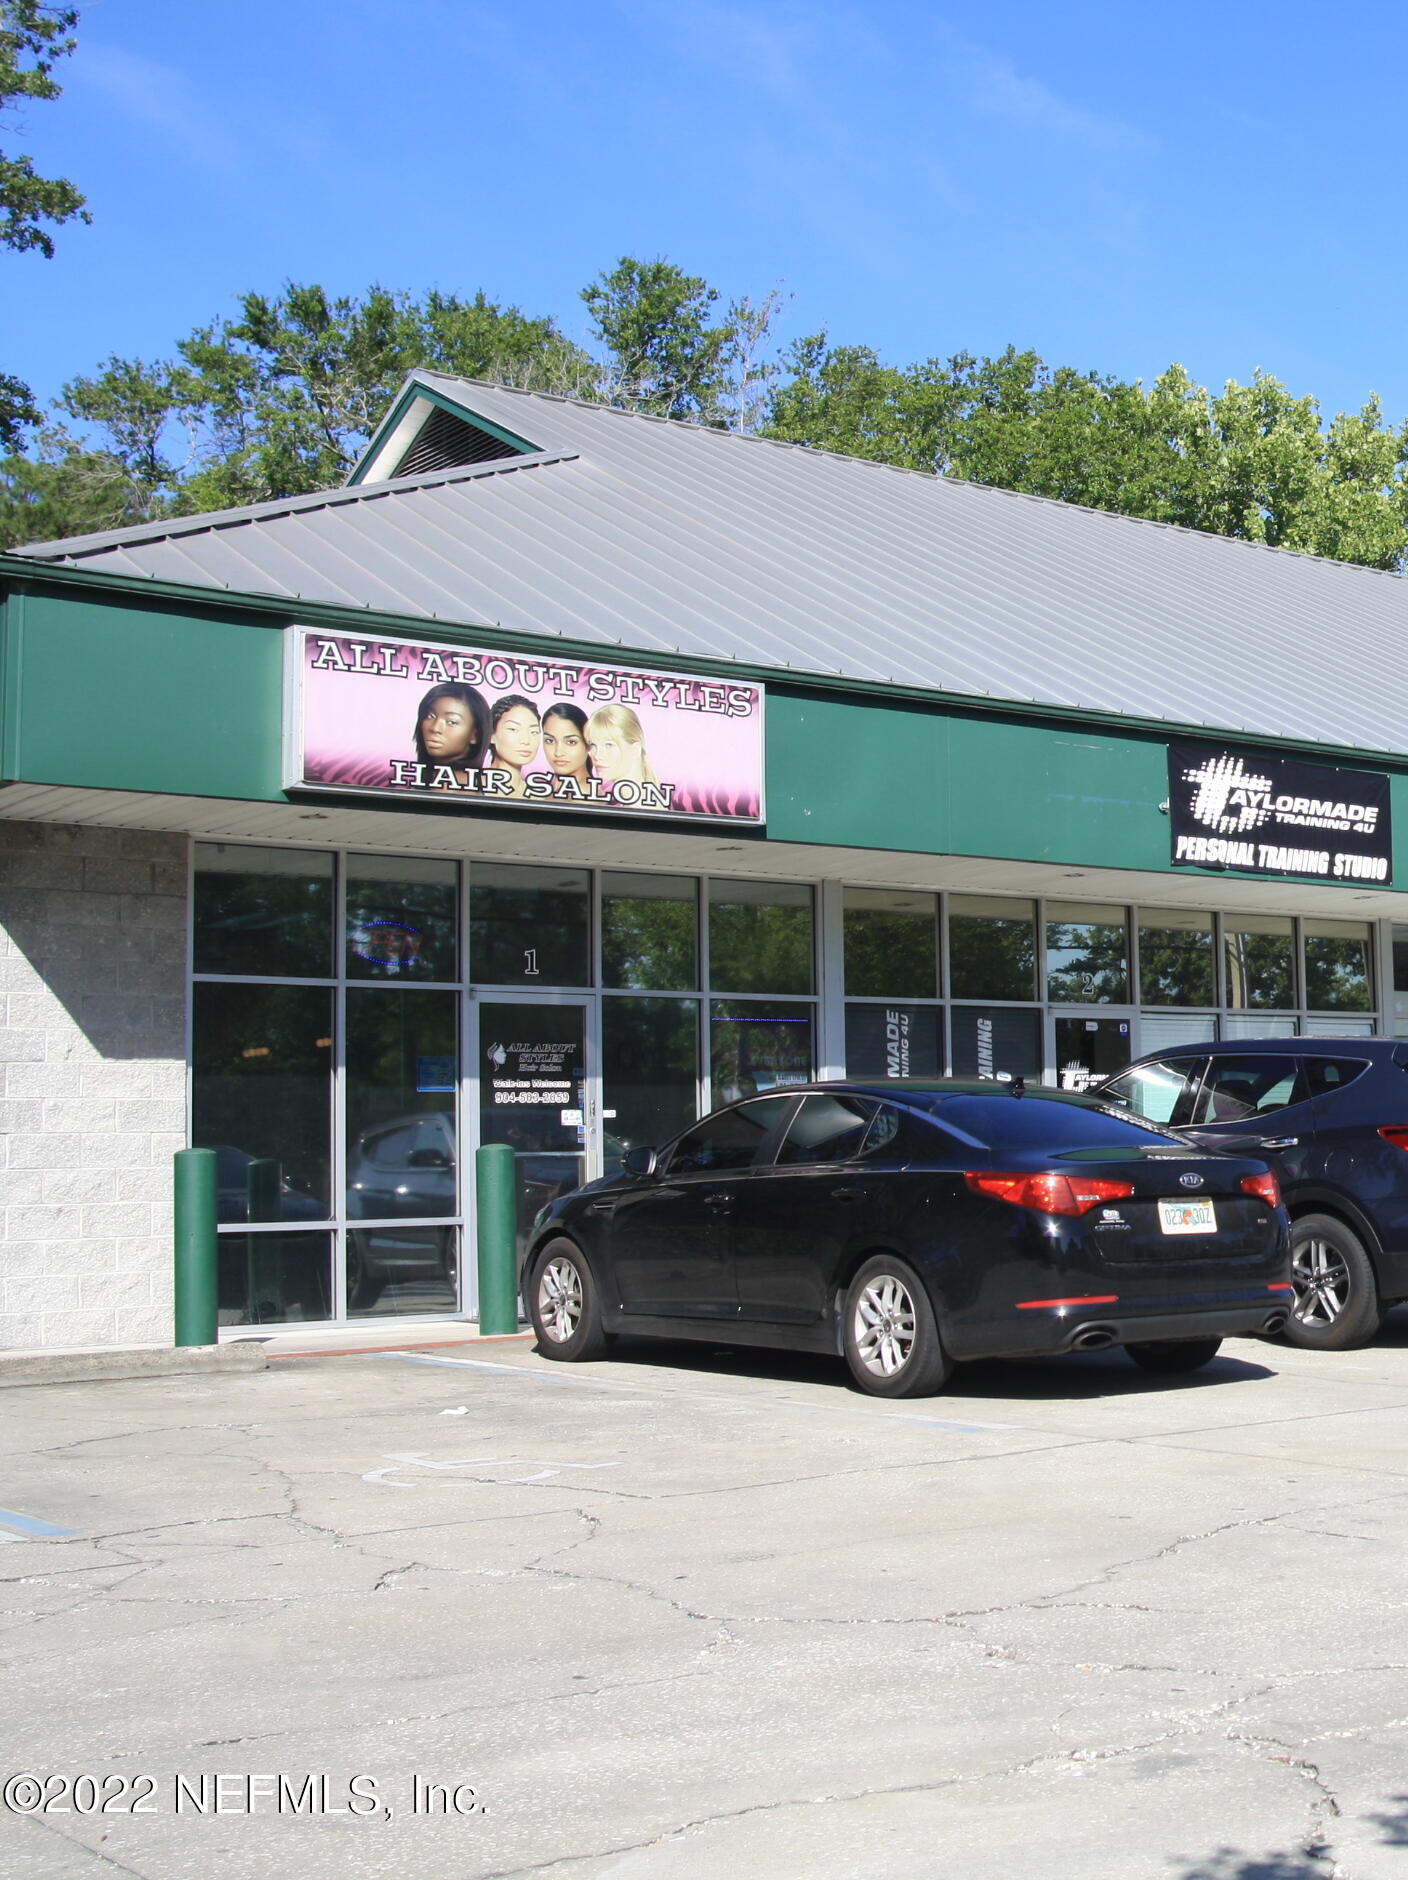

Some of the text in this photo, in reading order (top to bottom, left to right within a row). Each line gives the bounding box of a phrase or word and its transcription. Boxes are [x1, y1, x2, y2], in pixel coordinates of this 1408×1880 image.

[312, 639, 753, 718] ALL ABOUT STYLES
[390, 760, 676, 810] HAIR SALON
[1275, 813, 1375, 834] TRAINING 4U
[1176, 836, 1388, 881] PERSONAL TRAINING STUDIO
[524, 949, 539, 975] 1
[1081, 972, 1095, 995] 2
